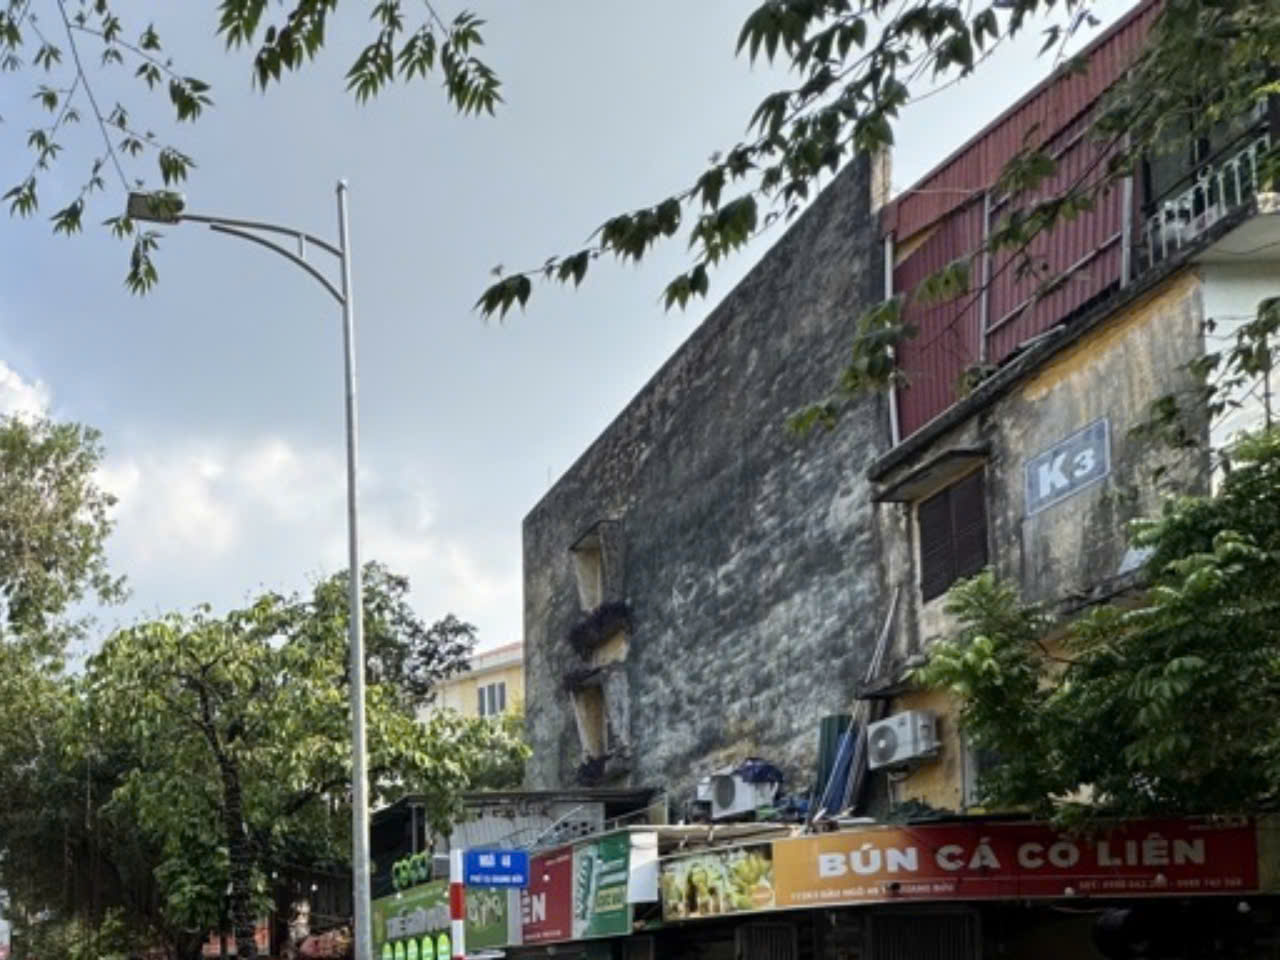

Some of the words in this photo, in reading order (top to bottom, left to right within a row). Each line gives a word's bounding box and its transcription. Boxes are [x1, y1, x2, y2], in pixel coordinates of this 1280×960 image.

[1039, 448, 1095, 498] K3
[818, 843, 918, 878] BÚN
[935, 837, 1001, 871] CÁ
[1097, 832, 1205, 867] LIÊN
